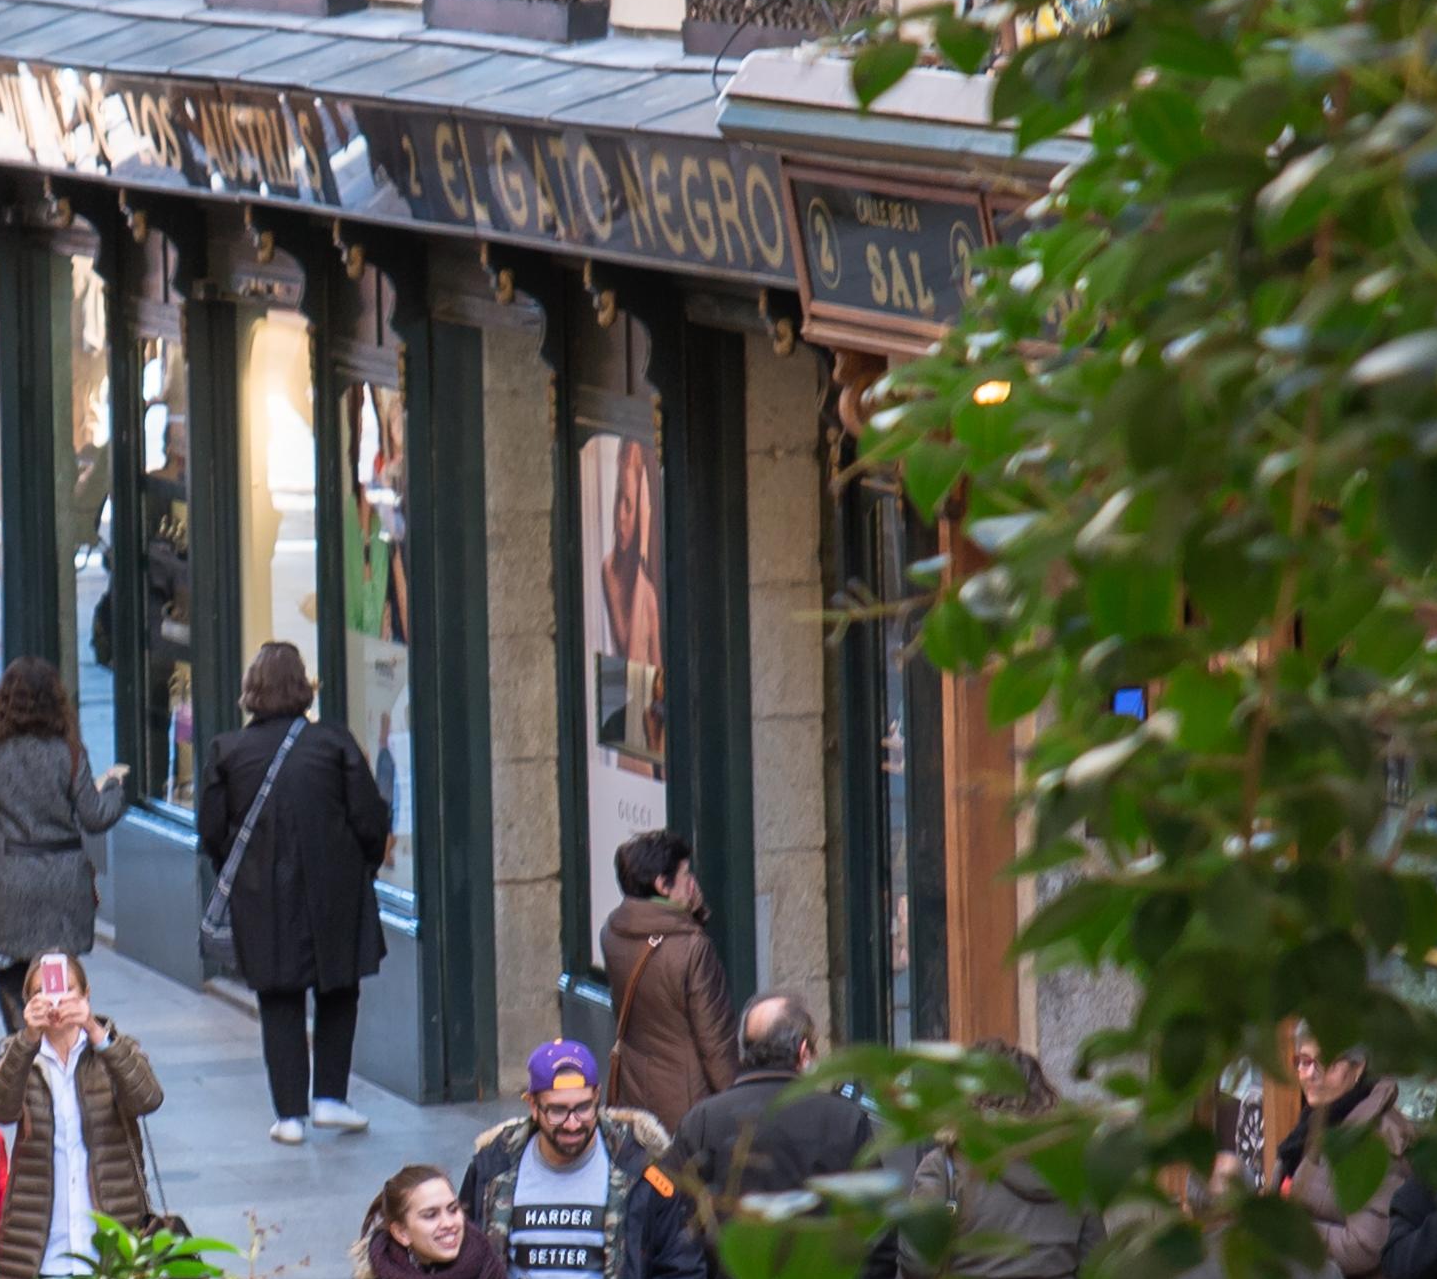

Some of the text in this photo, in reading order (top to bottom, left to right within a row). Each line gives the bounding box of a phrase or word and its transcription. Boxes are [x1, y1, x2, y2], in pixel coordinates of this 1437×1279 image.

[124, 89, 182, 174] LOS
[435, 121, 492, 226] EL
[493, 125, 613, 243] GATO
[616, 145, 785, 271] NEGRO
[814, 212, 835, 273] 2
[865, 242, 935, 315] SAL
[525, 1208, 593, 1227] HARDER
[528, 1247, 588, 1266] BETTER
